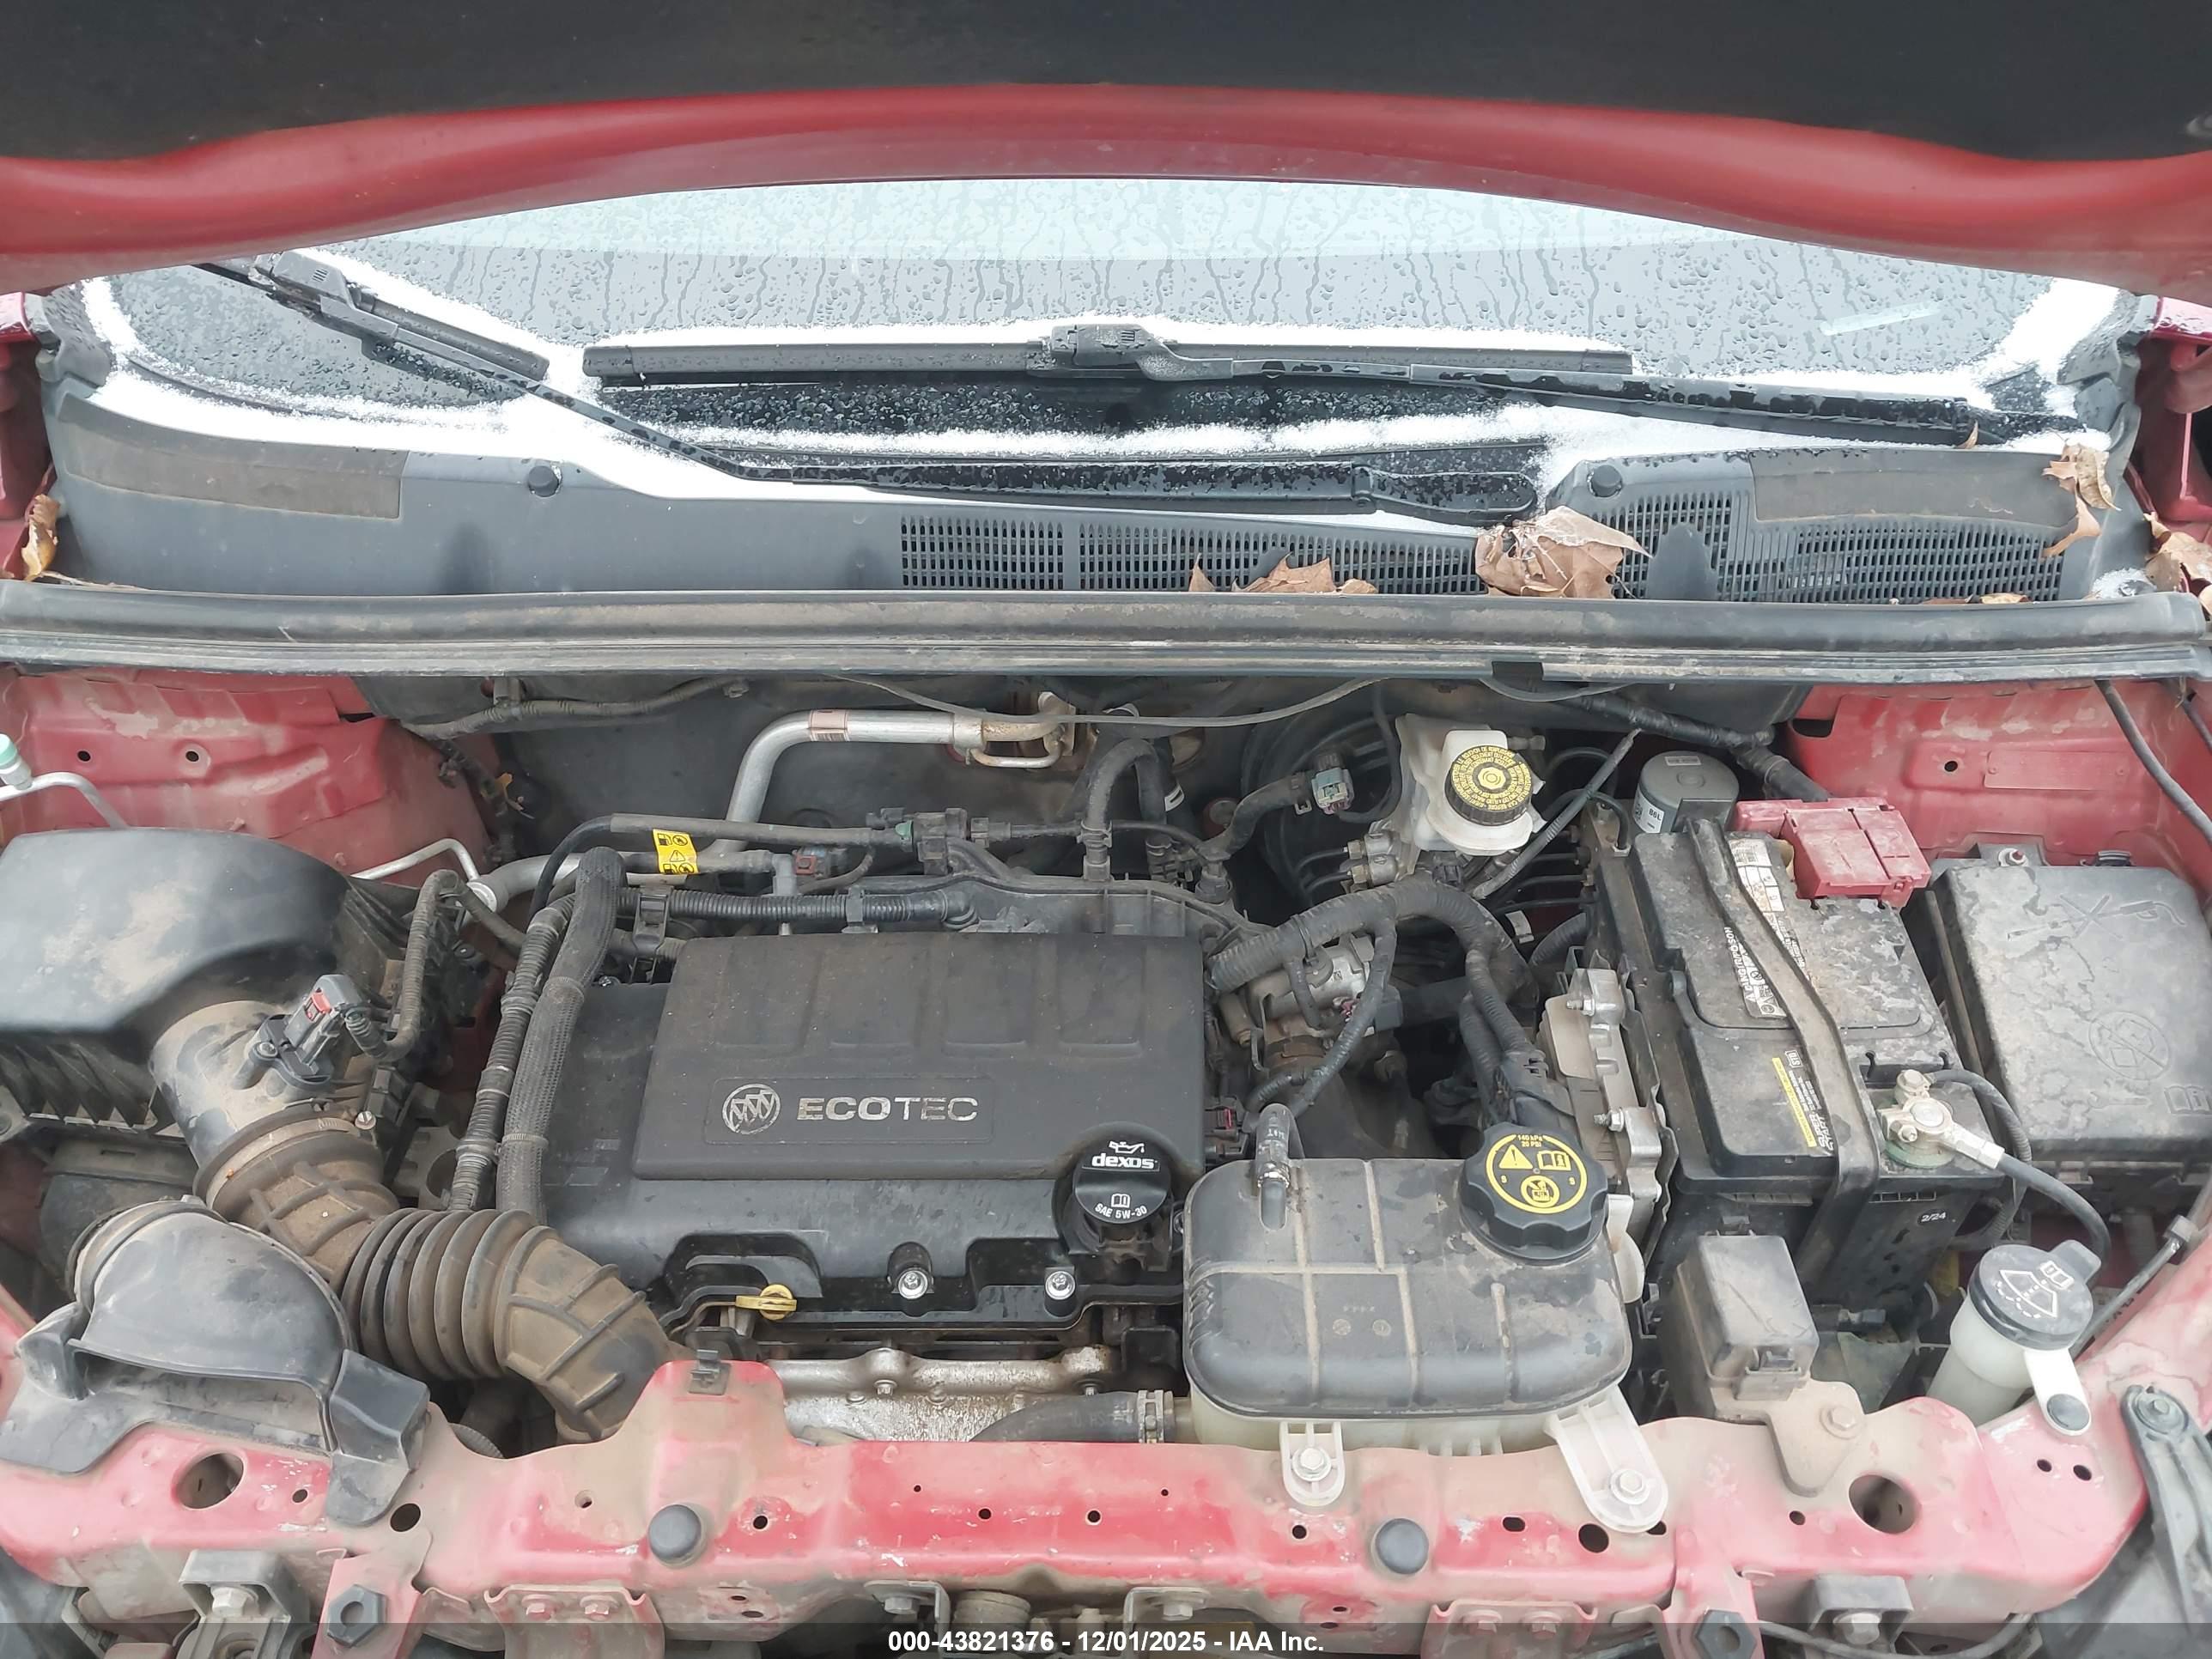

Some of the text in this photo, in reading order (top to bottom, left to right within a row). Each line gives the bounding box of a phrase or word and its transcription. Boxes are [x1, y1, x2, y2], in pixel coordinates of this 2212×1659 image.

[797, 1096, 978, 1121] ECOTEC
[1091, 1152, 1155, 1170] dexos
[1095, 1202, 1147, 1219] SAE 5W-30
[1921, 1212, 1946, 1222] 2/24
